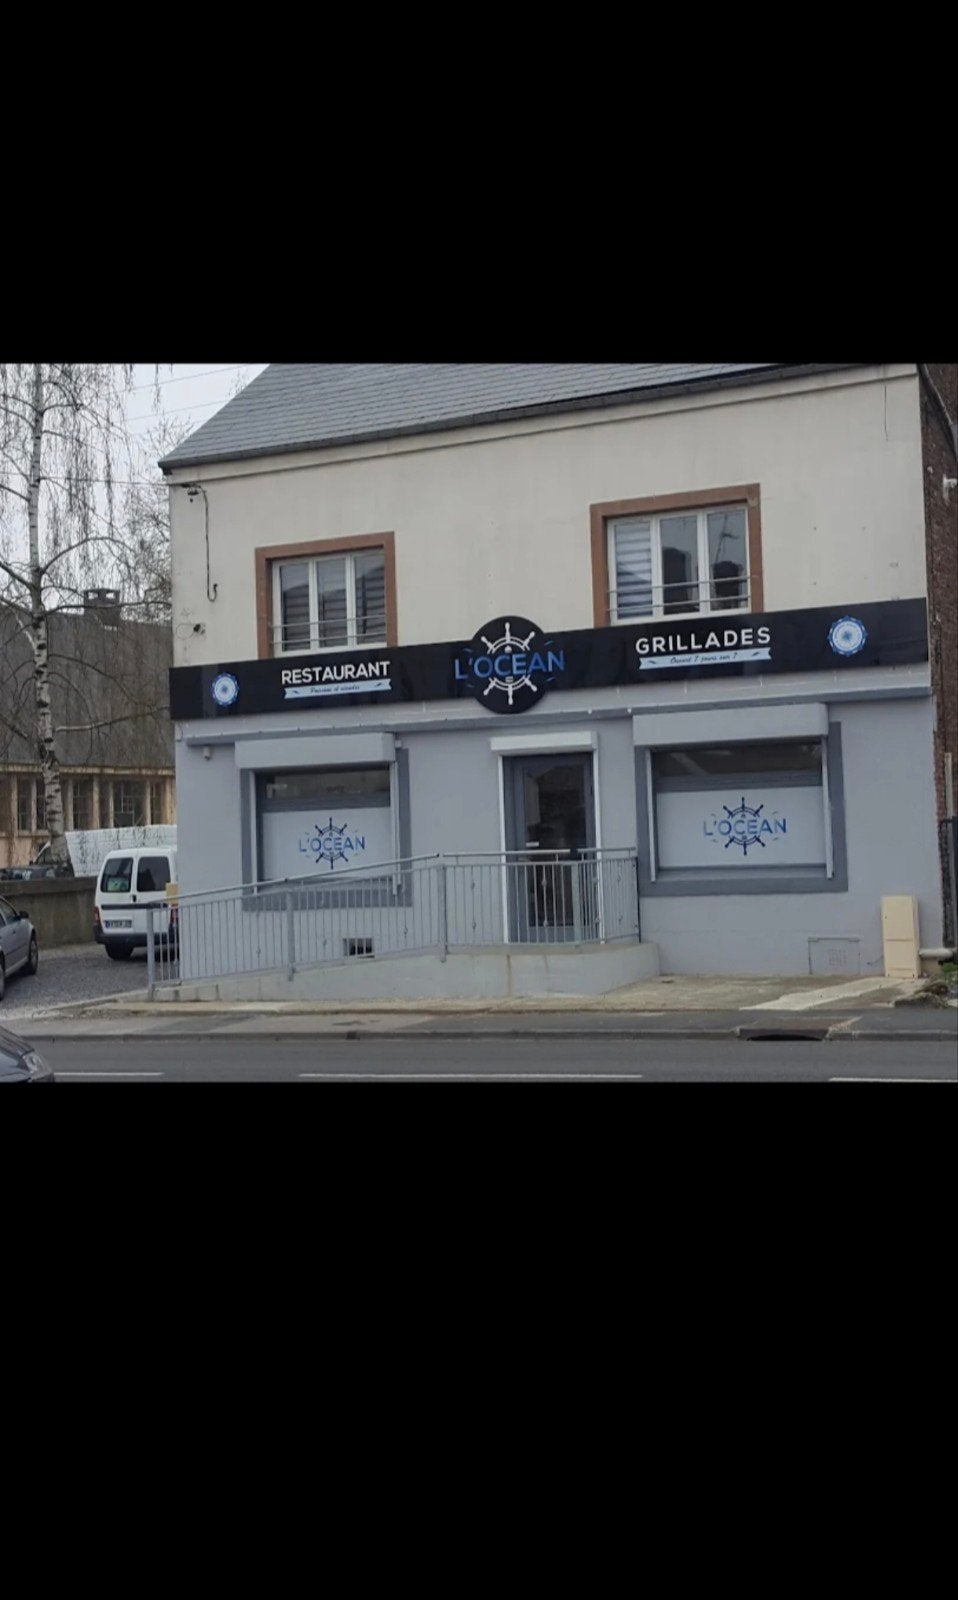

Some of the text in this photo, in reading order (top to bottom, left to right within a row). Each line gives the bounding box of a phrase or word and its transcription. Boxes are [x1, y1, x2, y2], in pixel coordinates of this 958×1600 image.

[635, 626, 771, 654] GRILLADES
[281, 661, 391, 685] RESTAURANT
[454, 650, 565, 680] L'OCEAN
[703, 818, 787, 836] L'OCEAN
[298, 836, 366, 852] L'OCEAN
